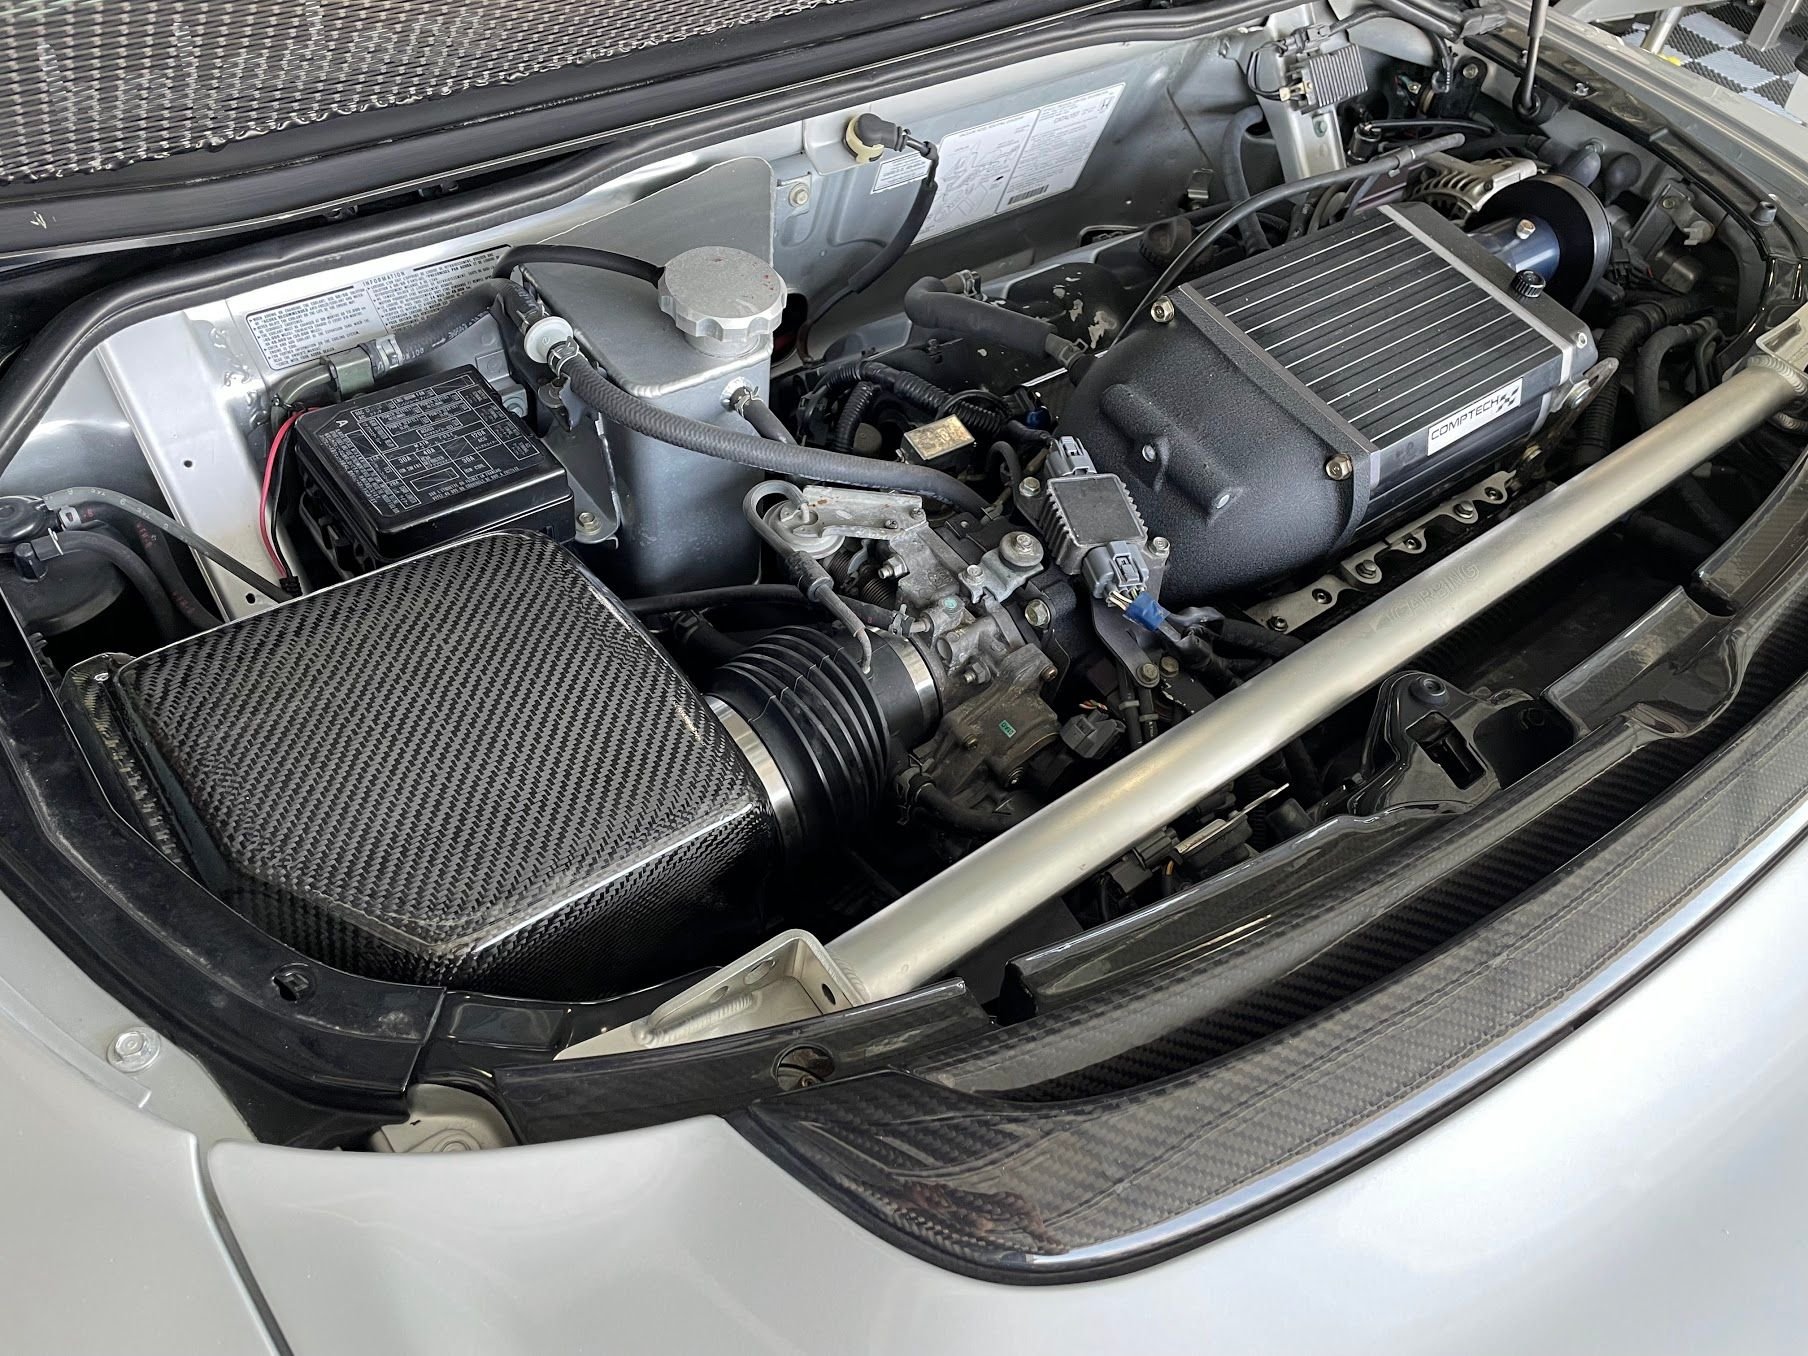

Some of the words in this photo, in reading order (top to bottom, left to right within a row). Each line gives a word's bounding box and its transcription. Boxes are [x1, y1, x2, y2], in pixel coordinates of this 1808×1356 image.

[362, 271, 406, 287] INFORMATION
[1430, 395, 1500, 441] COMPTECH
[1390, 563, 1480, 621] CARBING
